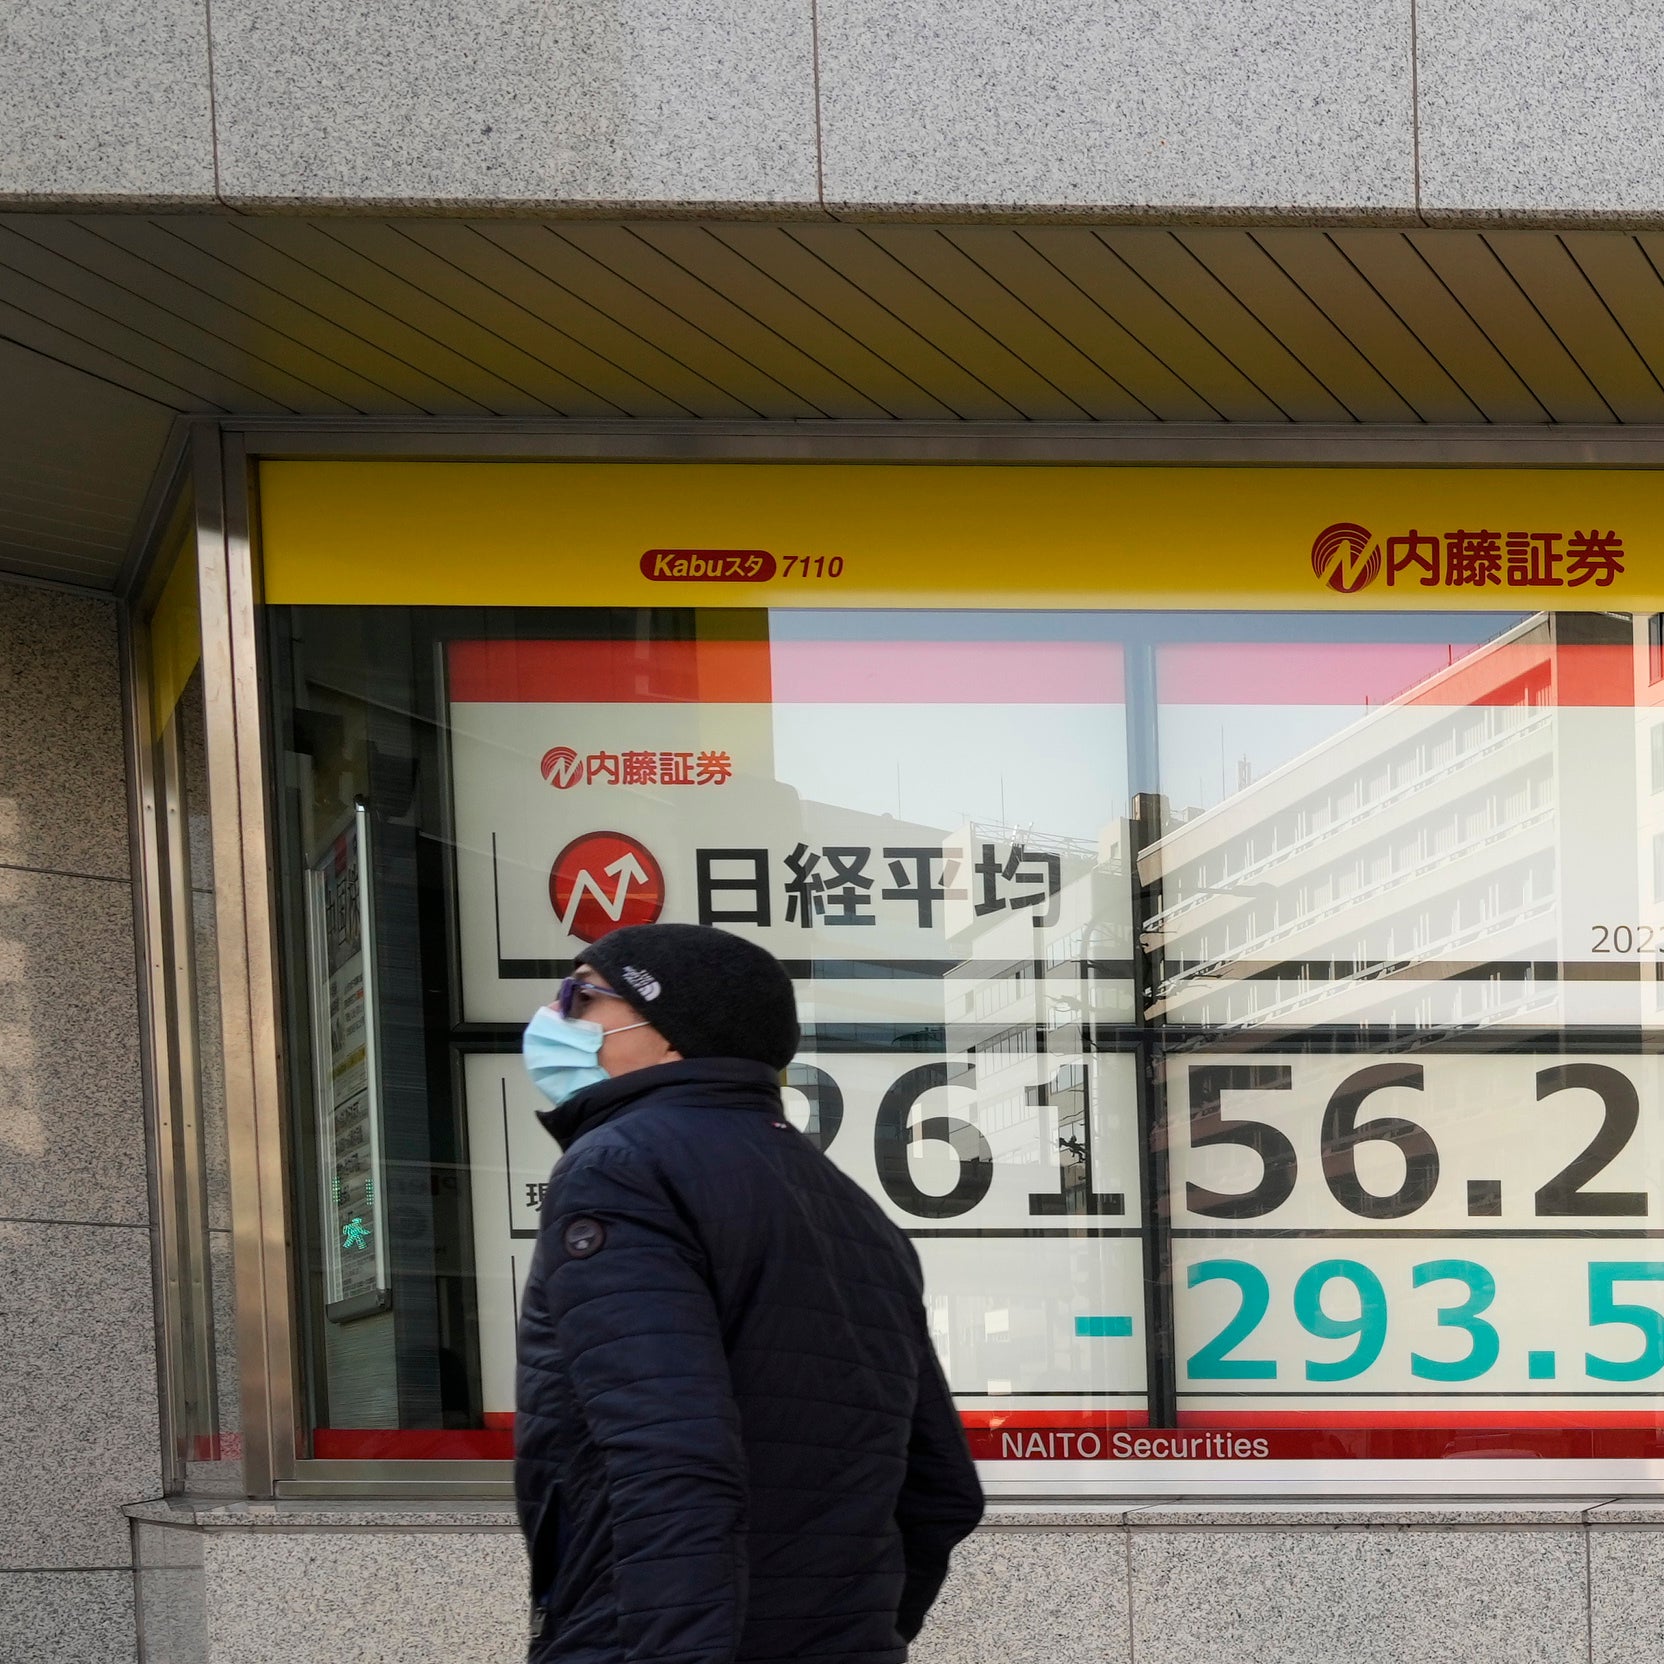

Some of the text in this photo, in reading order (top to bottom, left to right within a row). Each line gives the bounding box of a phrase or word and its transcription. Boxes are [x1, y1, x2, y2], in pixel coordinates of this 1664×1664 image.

[654, 552, 844, 578] Kabuスタ 7110
[1386, 529, 1624, 588] 内藤証券
[587, 751, 733, 785] 内藤証券
[695, 843, 1062, 928] 日経平均
[1001, 1432, 1269, 1458] NAITO Securities
